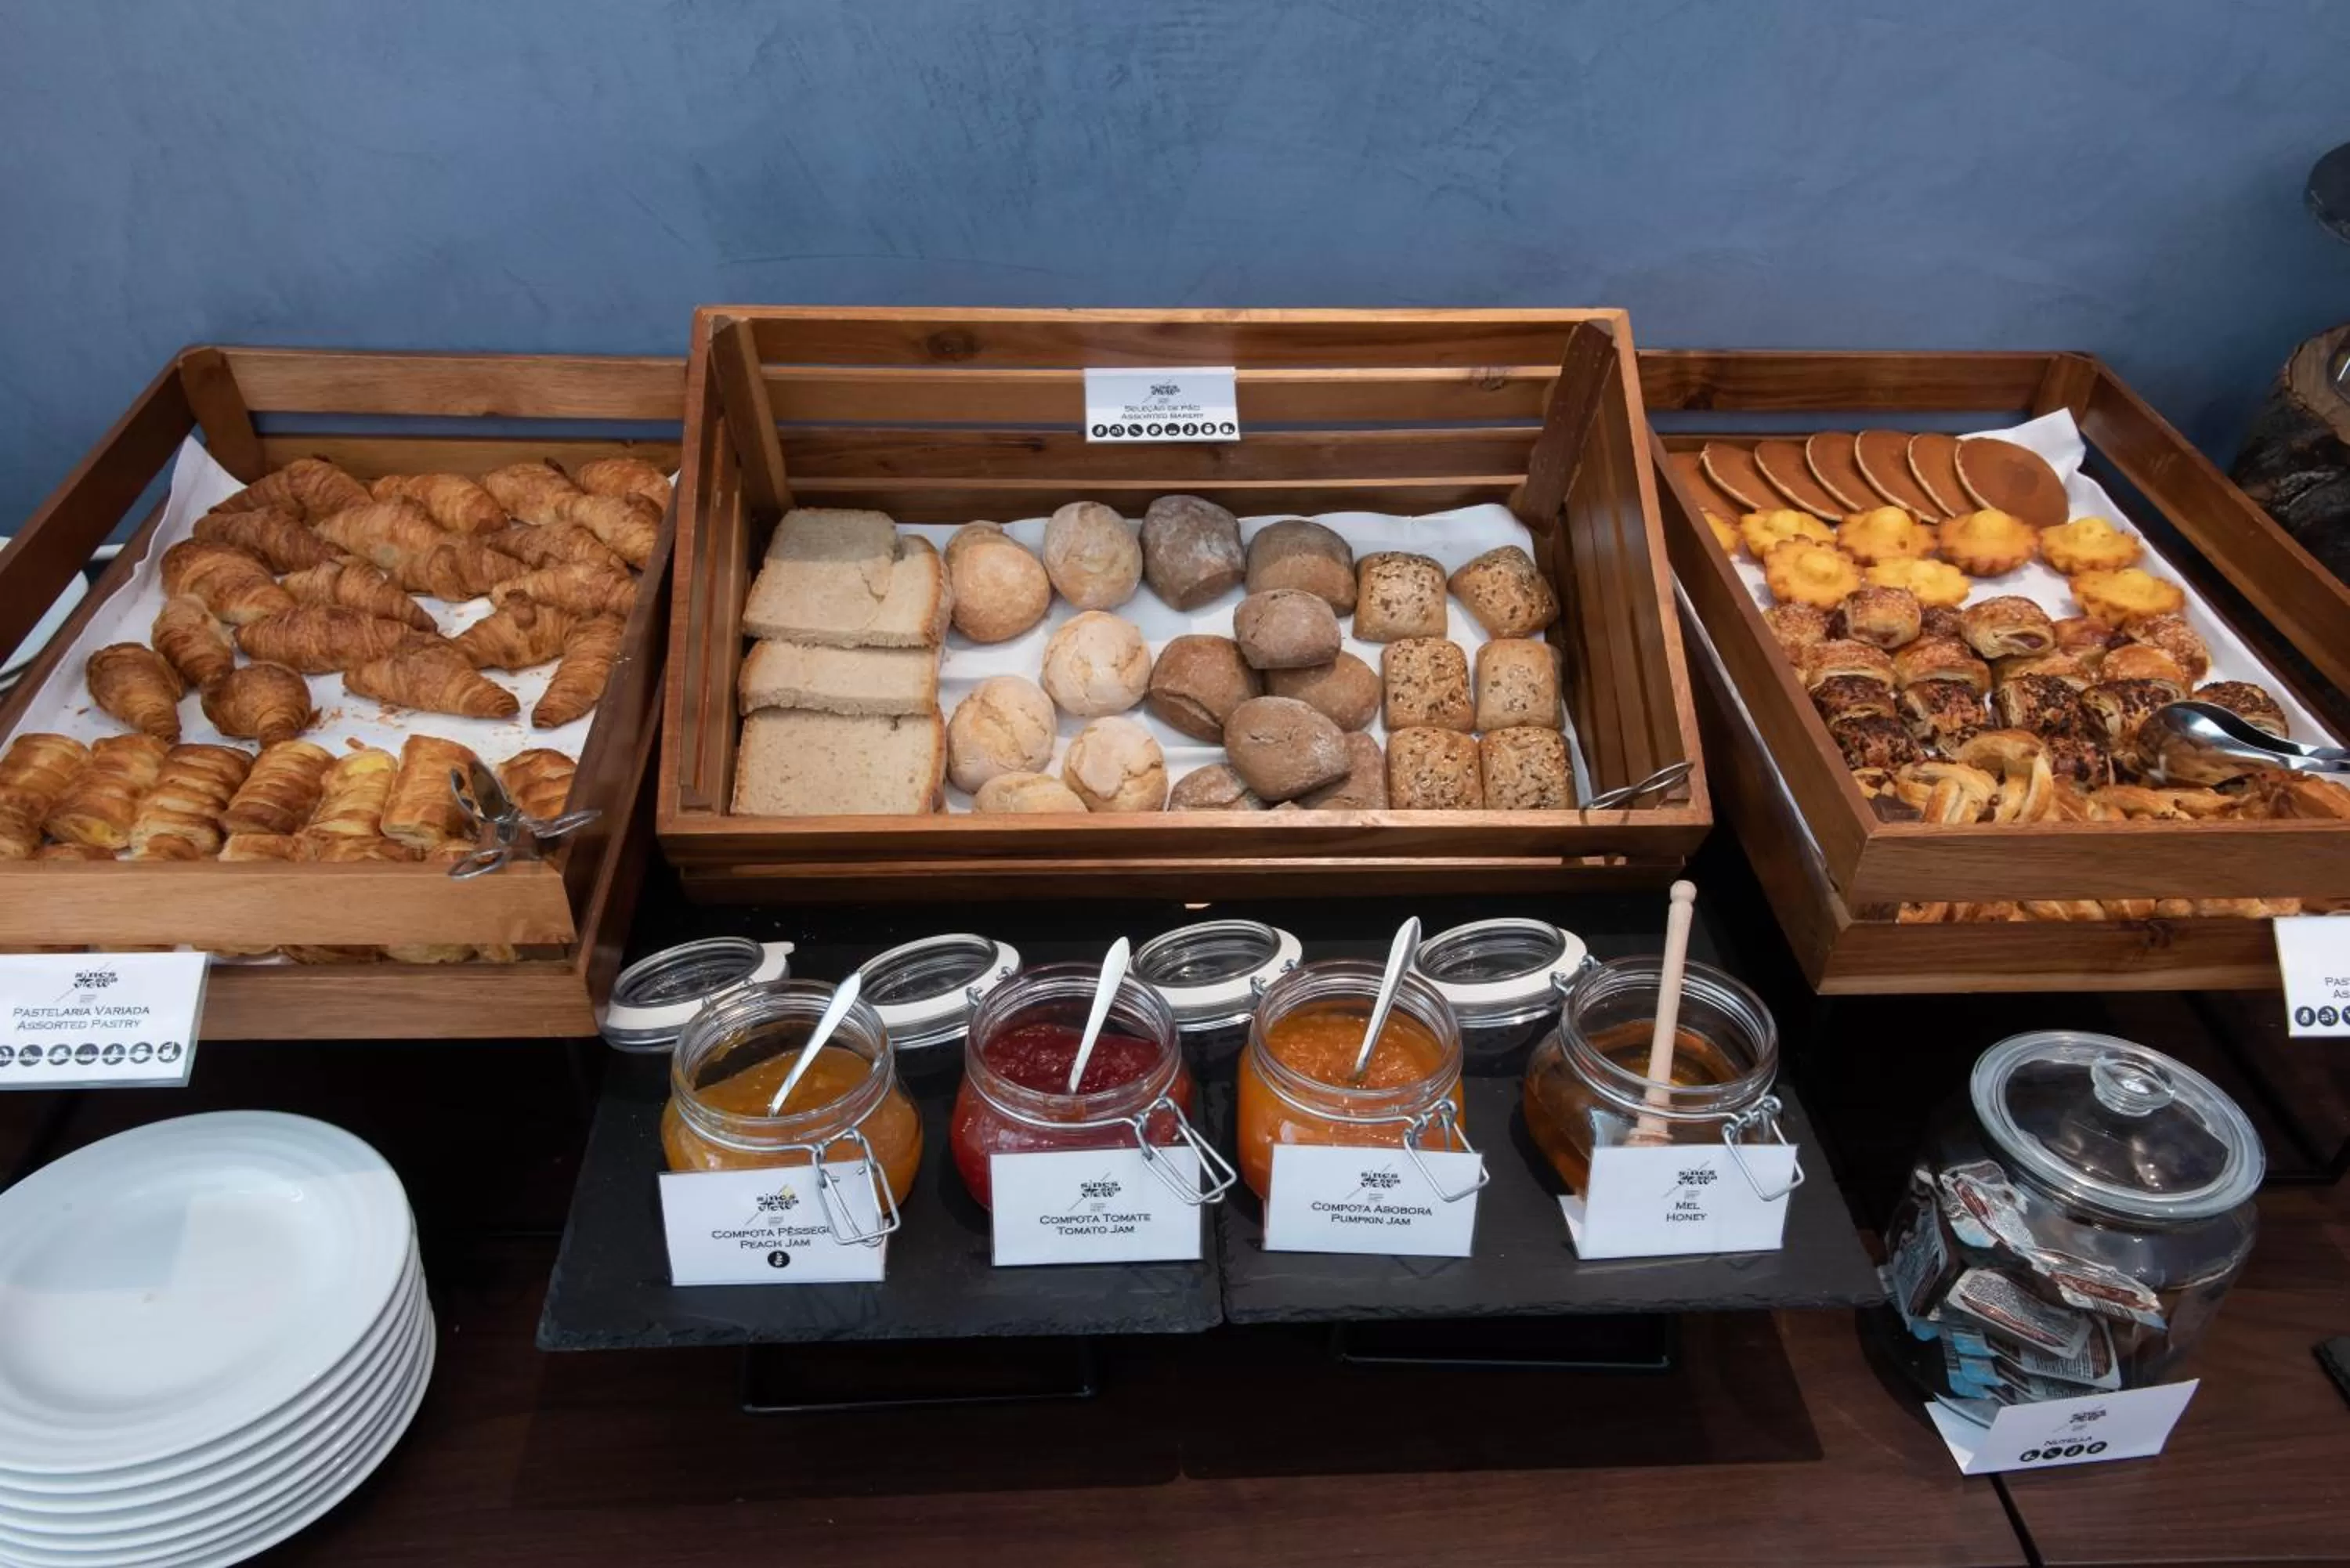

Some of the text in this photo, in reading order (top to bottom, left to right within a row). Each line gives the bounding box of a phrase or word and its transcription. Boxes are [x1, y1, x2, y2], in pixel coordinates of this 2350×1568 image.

[13, 1006, 150, 1017] PASTELARIA VARIADA
[16, 1019, 143, 1031] ASSORTED PASTRY
[1311, 1201, 1371, 1212] COMPOTA
[1676, 1201, 1700, 1210] MEL
[1039, 1213, 1151, 1224] COMPOTA TOMATE
[1332, 1214, 1411, 1226] PUMPKIN JAM
[1666, 1213, 1708, 1222] HONEY
[711, 1229, 775, 1239] COMPOTA
[1058, 1225, 1135, 1235] TOMATO JAM
[739, 1239, 811, 1249] PEACH JAM
